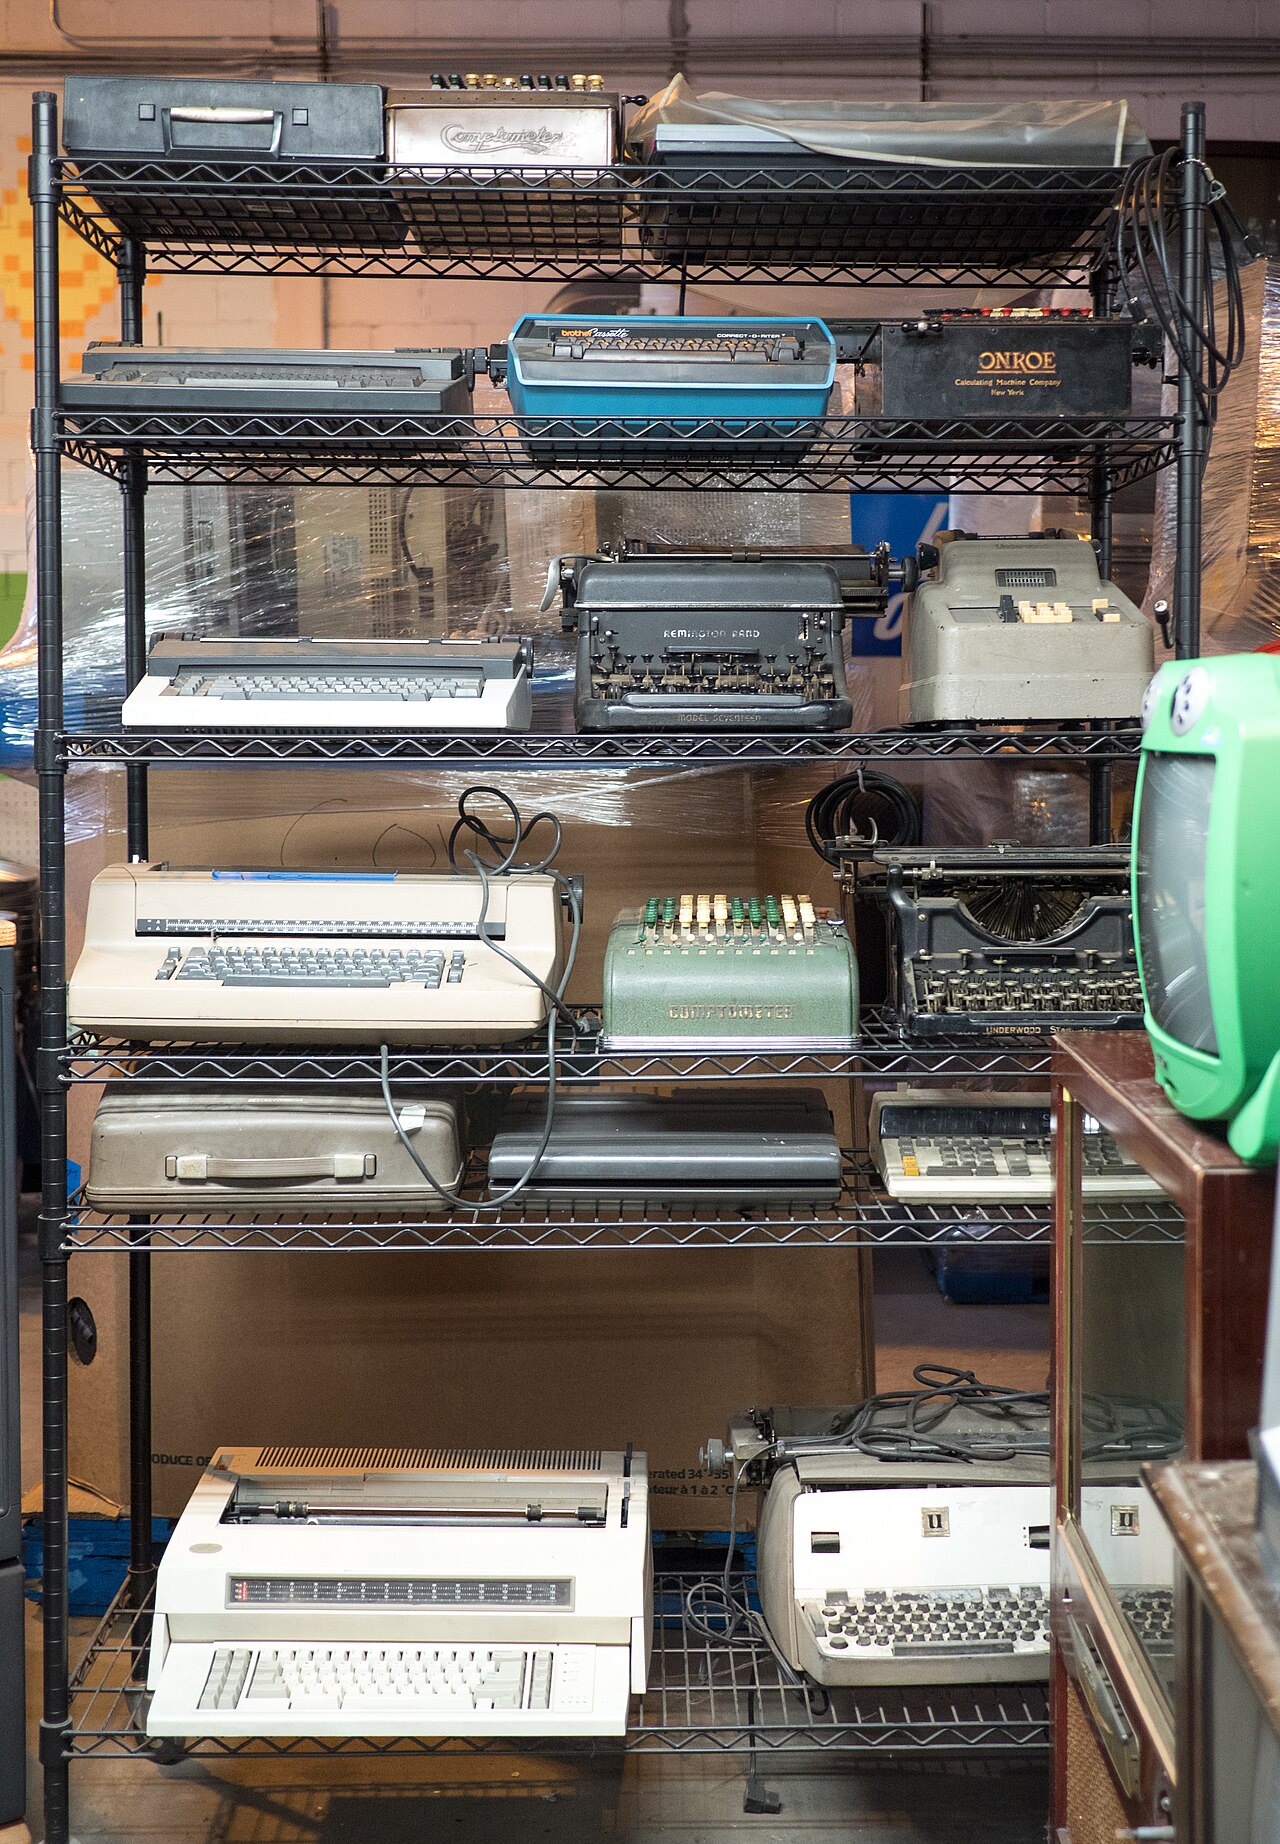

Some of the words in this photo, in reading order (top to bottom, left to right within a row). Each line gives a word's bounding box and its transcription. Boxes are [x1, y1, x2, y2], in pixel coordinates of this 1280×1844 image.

[440, 124, 564, 154] Comptometer
[561, 328, 592, 337] brother
[590, 327, 630, 338] Cassette
[954, 379, 993, 387] Calculating
[1029, 379, 1062, 388] Company
[663, 629, 727, 640] REMINGTON
[732, 629, 761, 638] RAND
[677, 714, 709, 722] MODEL
[713, 714, 762, 722] SEVENTEEN
[669, 1004, 796, 1020] COMPTOMETER
[986, 1026, 1042, 1034] UNDERWOOD
